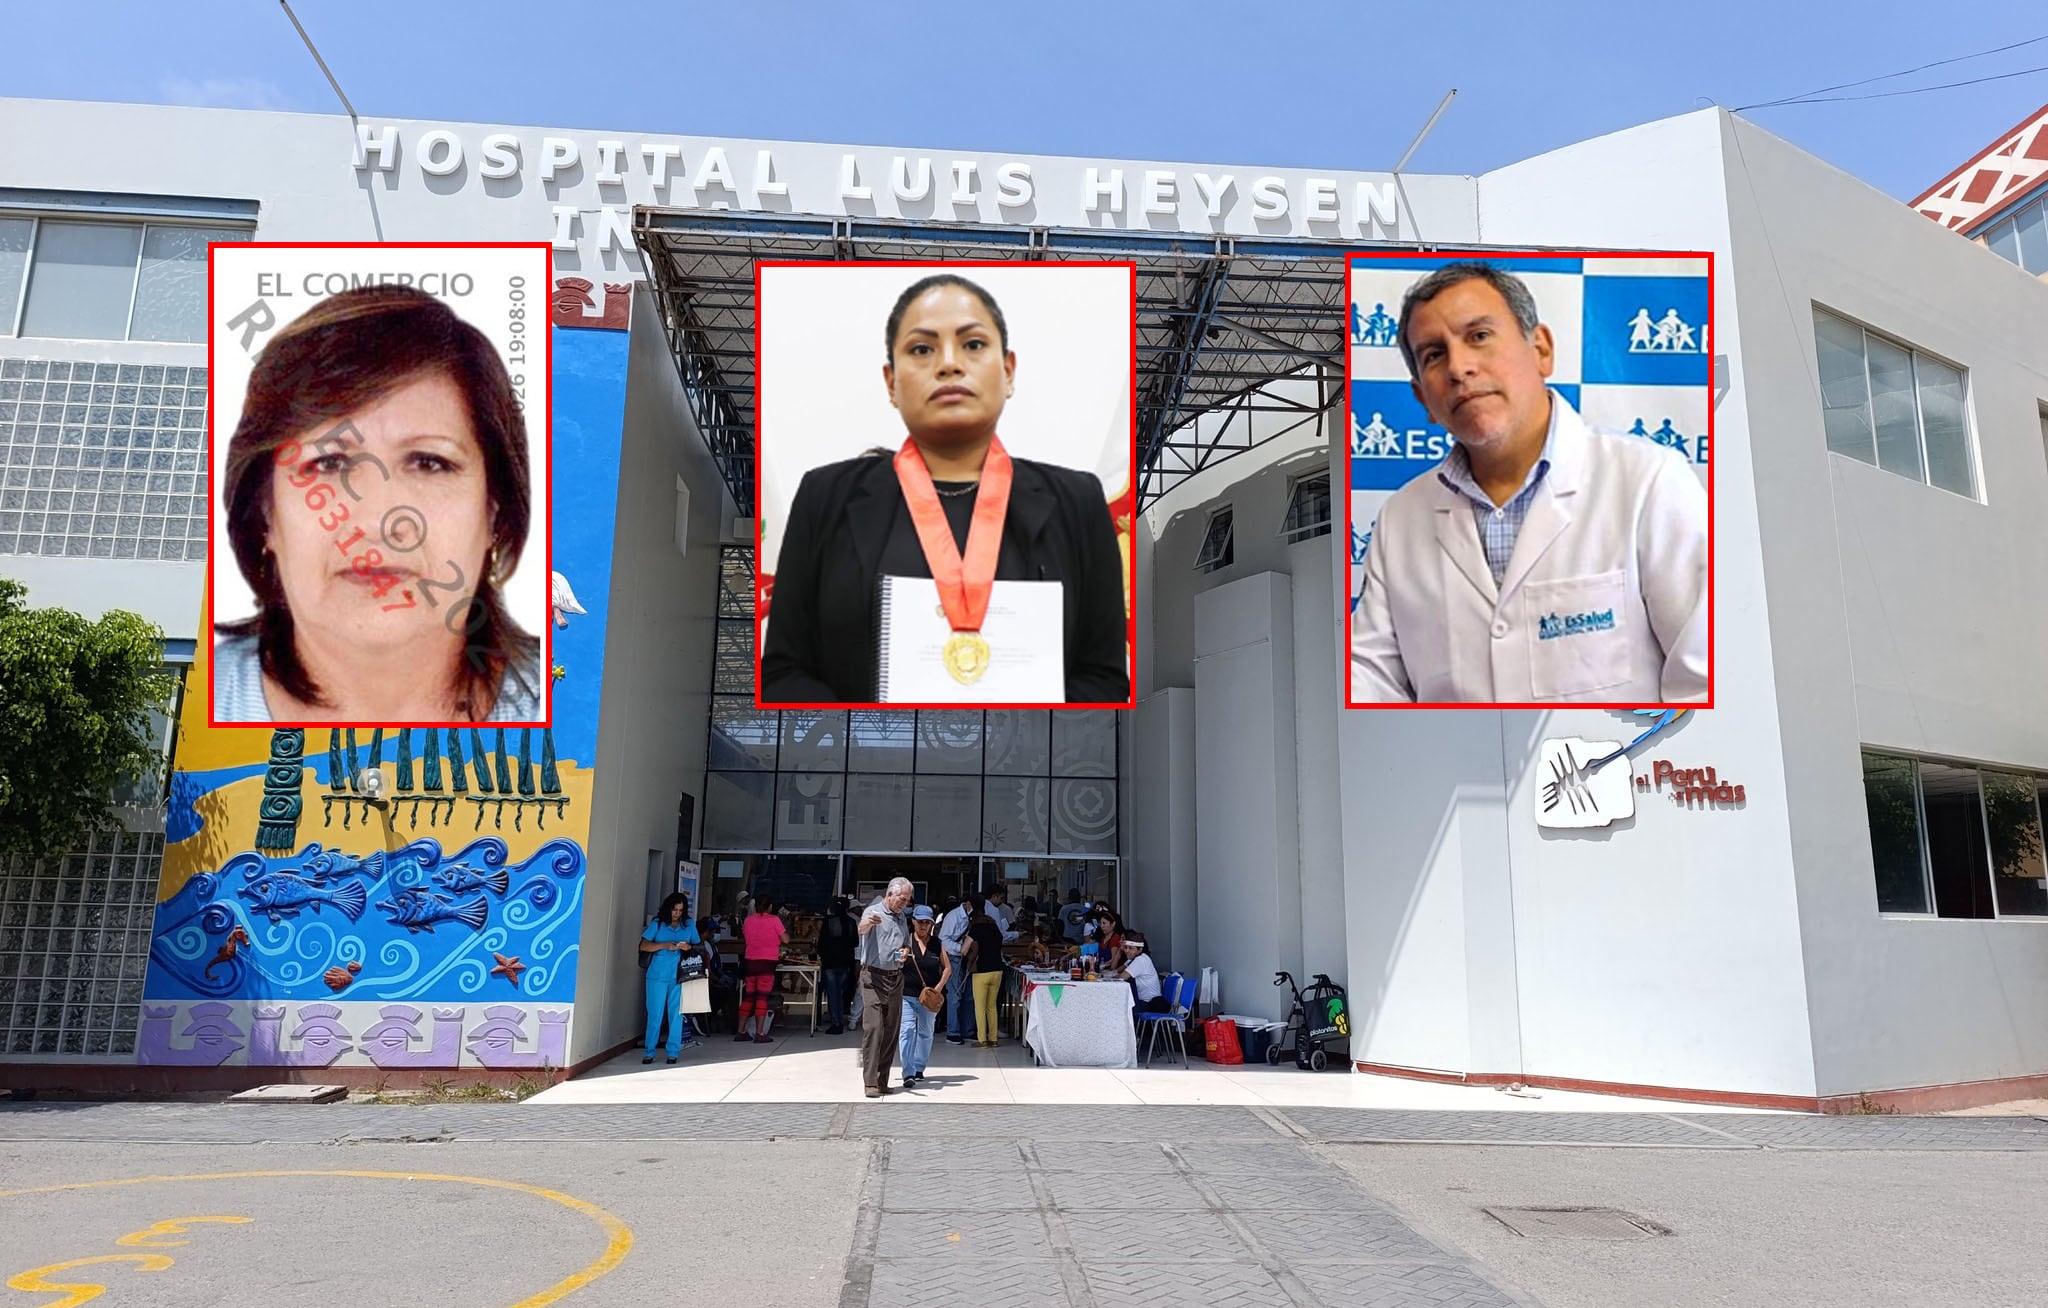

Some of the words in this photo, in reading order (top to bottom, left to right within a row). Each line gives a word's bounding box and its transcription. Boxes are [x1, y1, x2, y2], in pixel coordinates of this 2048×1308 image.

[353, 125, 787, 196] HOSPITAL
[842, 155, 1033, 208] LUIS
[1084, 168, 1399, 226] HEYSEN
[1636, 774, 1650, 786] el
[1685, 781, 1745, 803] más
